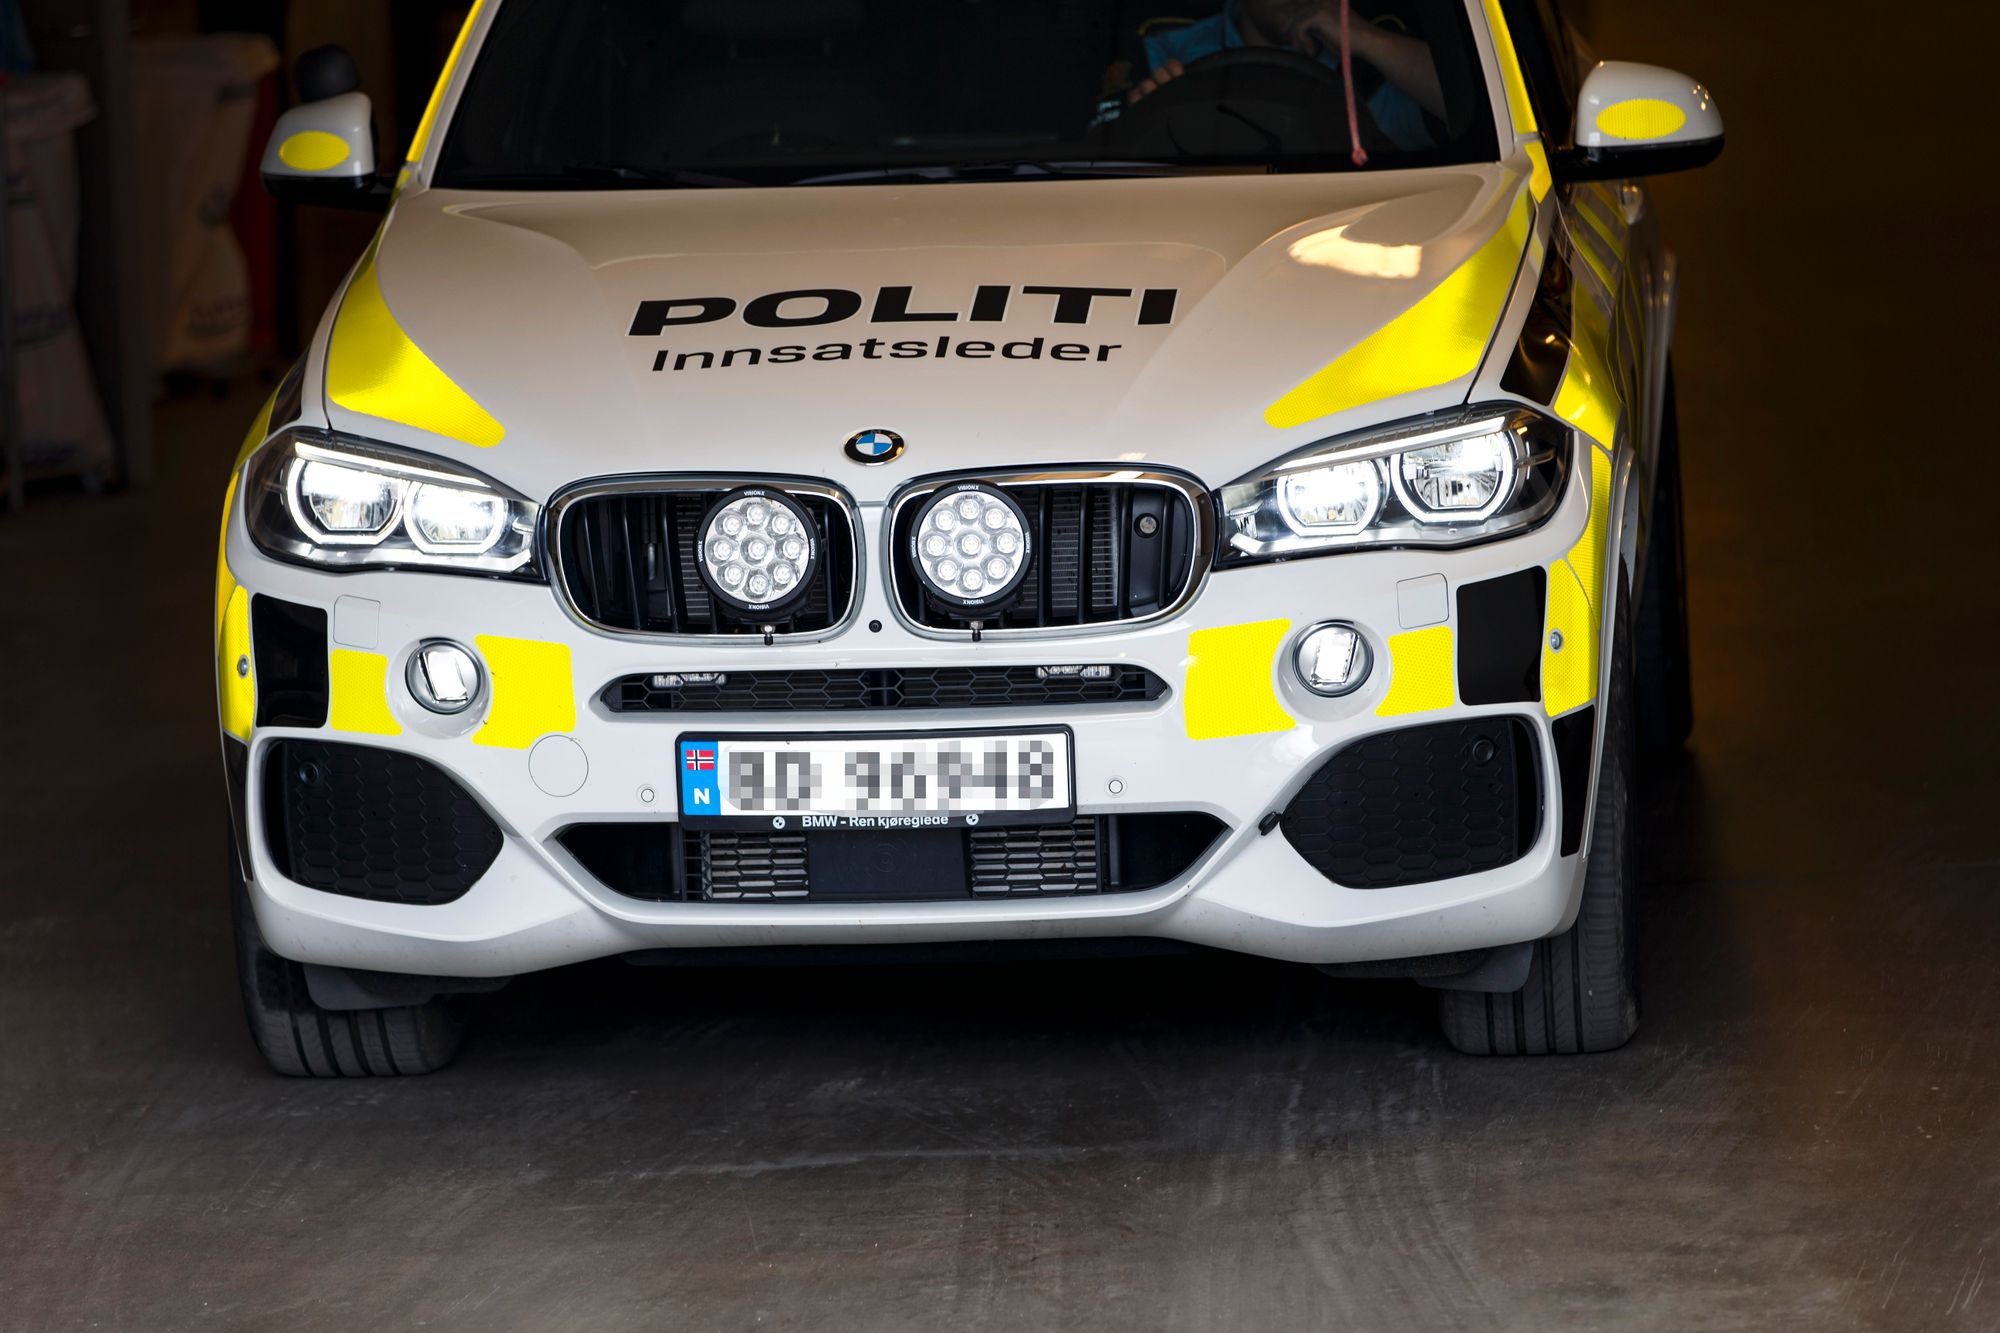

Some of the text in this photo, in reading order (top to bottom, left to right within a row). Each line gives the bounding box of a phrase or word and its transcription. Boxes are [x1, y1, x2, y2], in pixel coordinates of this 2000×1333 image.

[627, 284, 1179, 337] POLITI
[652, 335, 1123, 372] Innsatsleder
[694, 787, 710, 805] N
[802, 815, 838, 828] BMW
[849, 816, 876, 828] Ren
